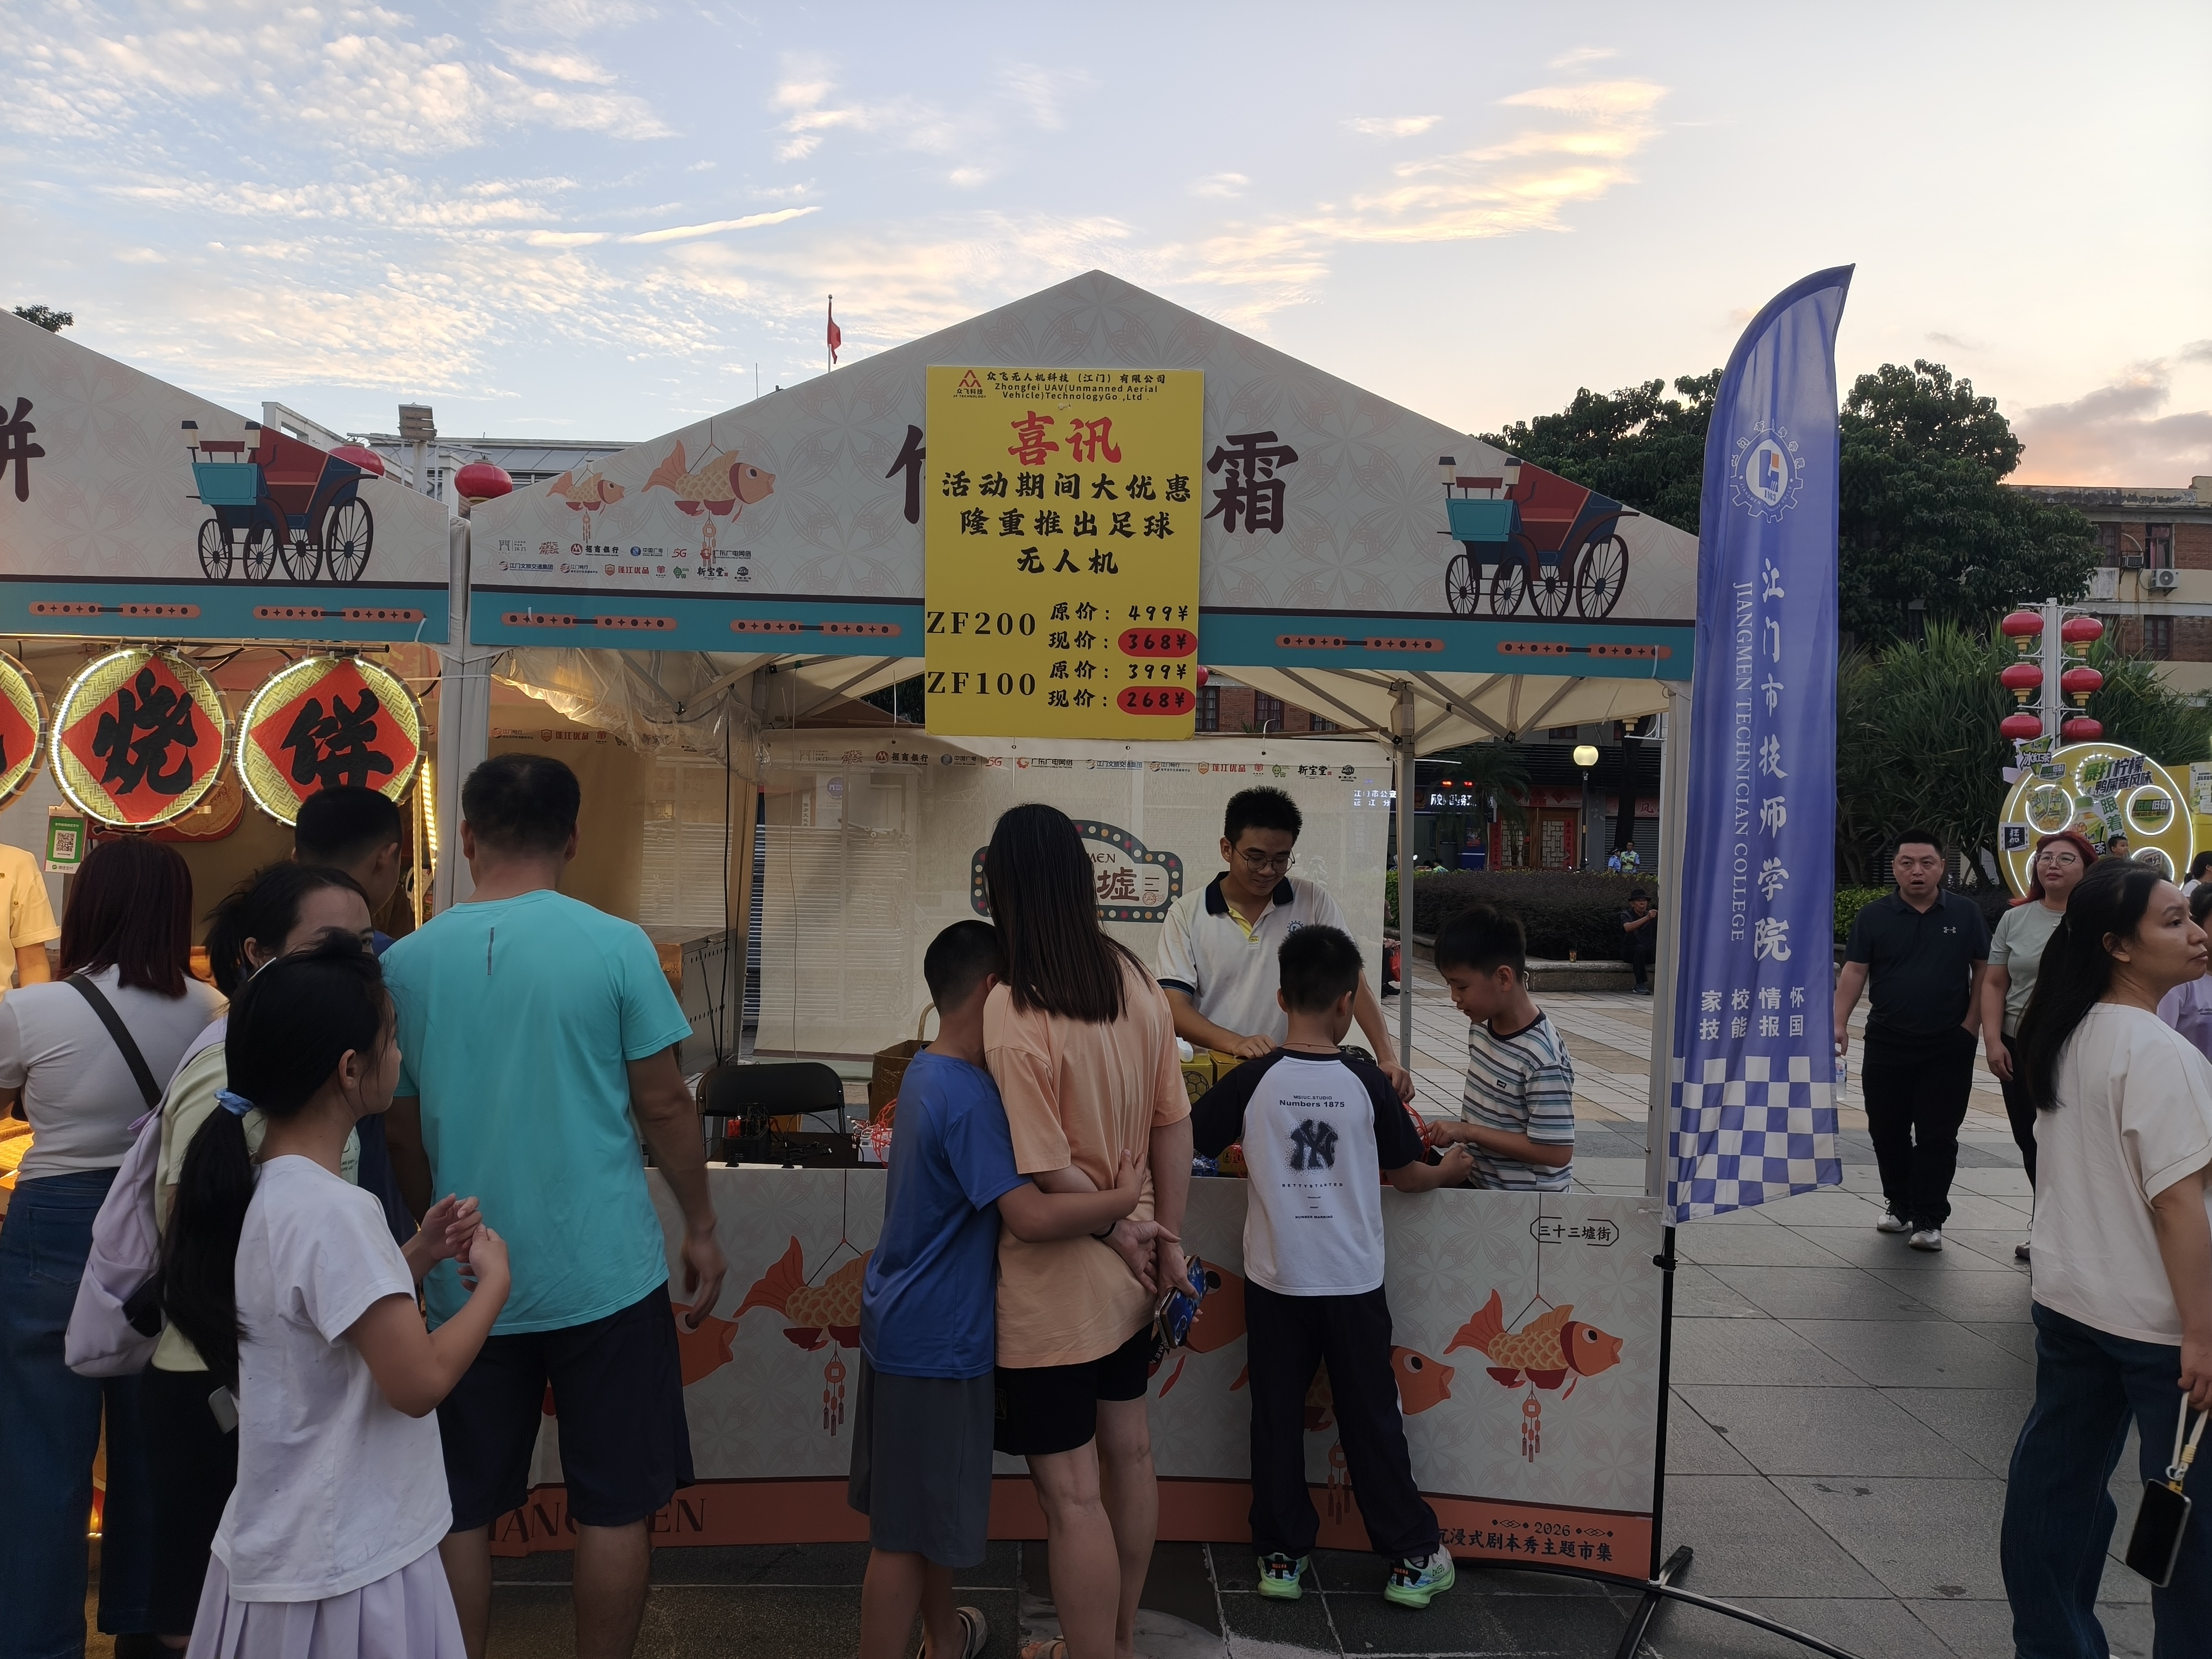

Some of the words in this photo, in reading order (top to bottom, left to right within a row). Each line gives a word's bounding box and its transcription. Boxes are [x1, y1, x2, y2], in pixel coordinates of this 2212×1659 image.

[987, 371, 1166, 383] 众飞无人机科技（江门）有限公司
[995, 383, 1041, 392] Zhongfei
[1044, 383, 1124, 394] UAV(Unmanned
[1127, 385, 1158, 393] Aerial
[1008, 410, 1122, 466] 喜讯
[942, 470, 1191, 503] 活动期间大优惠
[1204, 431, 1299, 534] 霜
[960, 507, 1175, 539] 隆重推出足球
[585, 545, 619, 554] 招商银行
[672, 548, 687, 558] 5G
[1017, 547, 1119, 575] 无人机
[697, 567, 725, 577] 新宝堂
[927, 611, 1036, 636] ZF200
[1128, 605, 1189, 622] 499¥
[1128, 633, 1187, 651] 368¥
[1733, 581, 1753, 691] JIANGMEN
[927, 671, 1036, 696] ZF100
[1128, 663, 1187, 680] 399¥
[1127, 692, 1185, 709] 268¥
[92, 667, 198, 795] 烧
[280, 689, 394, 788] 饼
[892, 752, 928, 762] 招商银行
[986, 756, 1003, 767] 5G
[1212, 763, 1246, 772] 蓬江优品
[1735, 698, 1751, 836] TECHNICIAN
[1754, 558, 1791, 961] 江门市技师学院
[2081, 755, 2146, 783] 暴打柠檬
[1298, 765, 1328, 776] 新宝堂
[2094, 771, 2154, 796] 鸭屎香风味
[1097, 867, 1139, 901] 墟
[1731, 842, 1748, 941] COLLEGE
[1701, 986, 1805, 1013] 家校情怀
[1699, 1014, 1804, 1041] 技能报国
[1539, 1224, 1611, 1241] 三十三墟街
[1534, 1522, 1571, 1536] 2026
